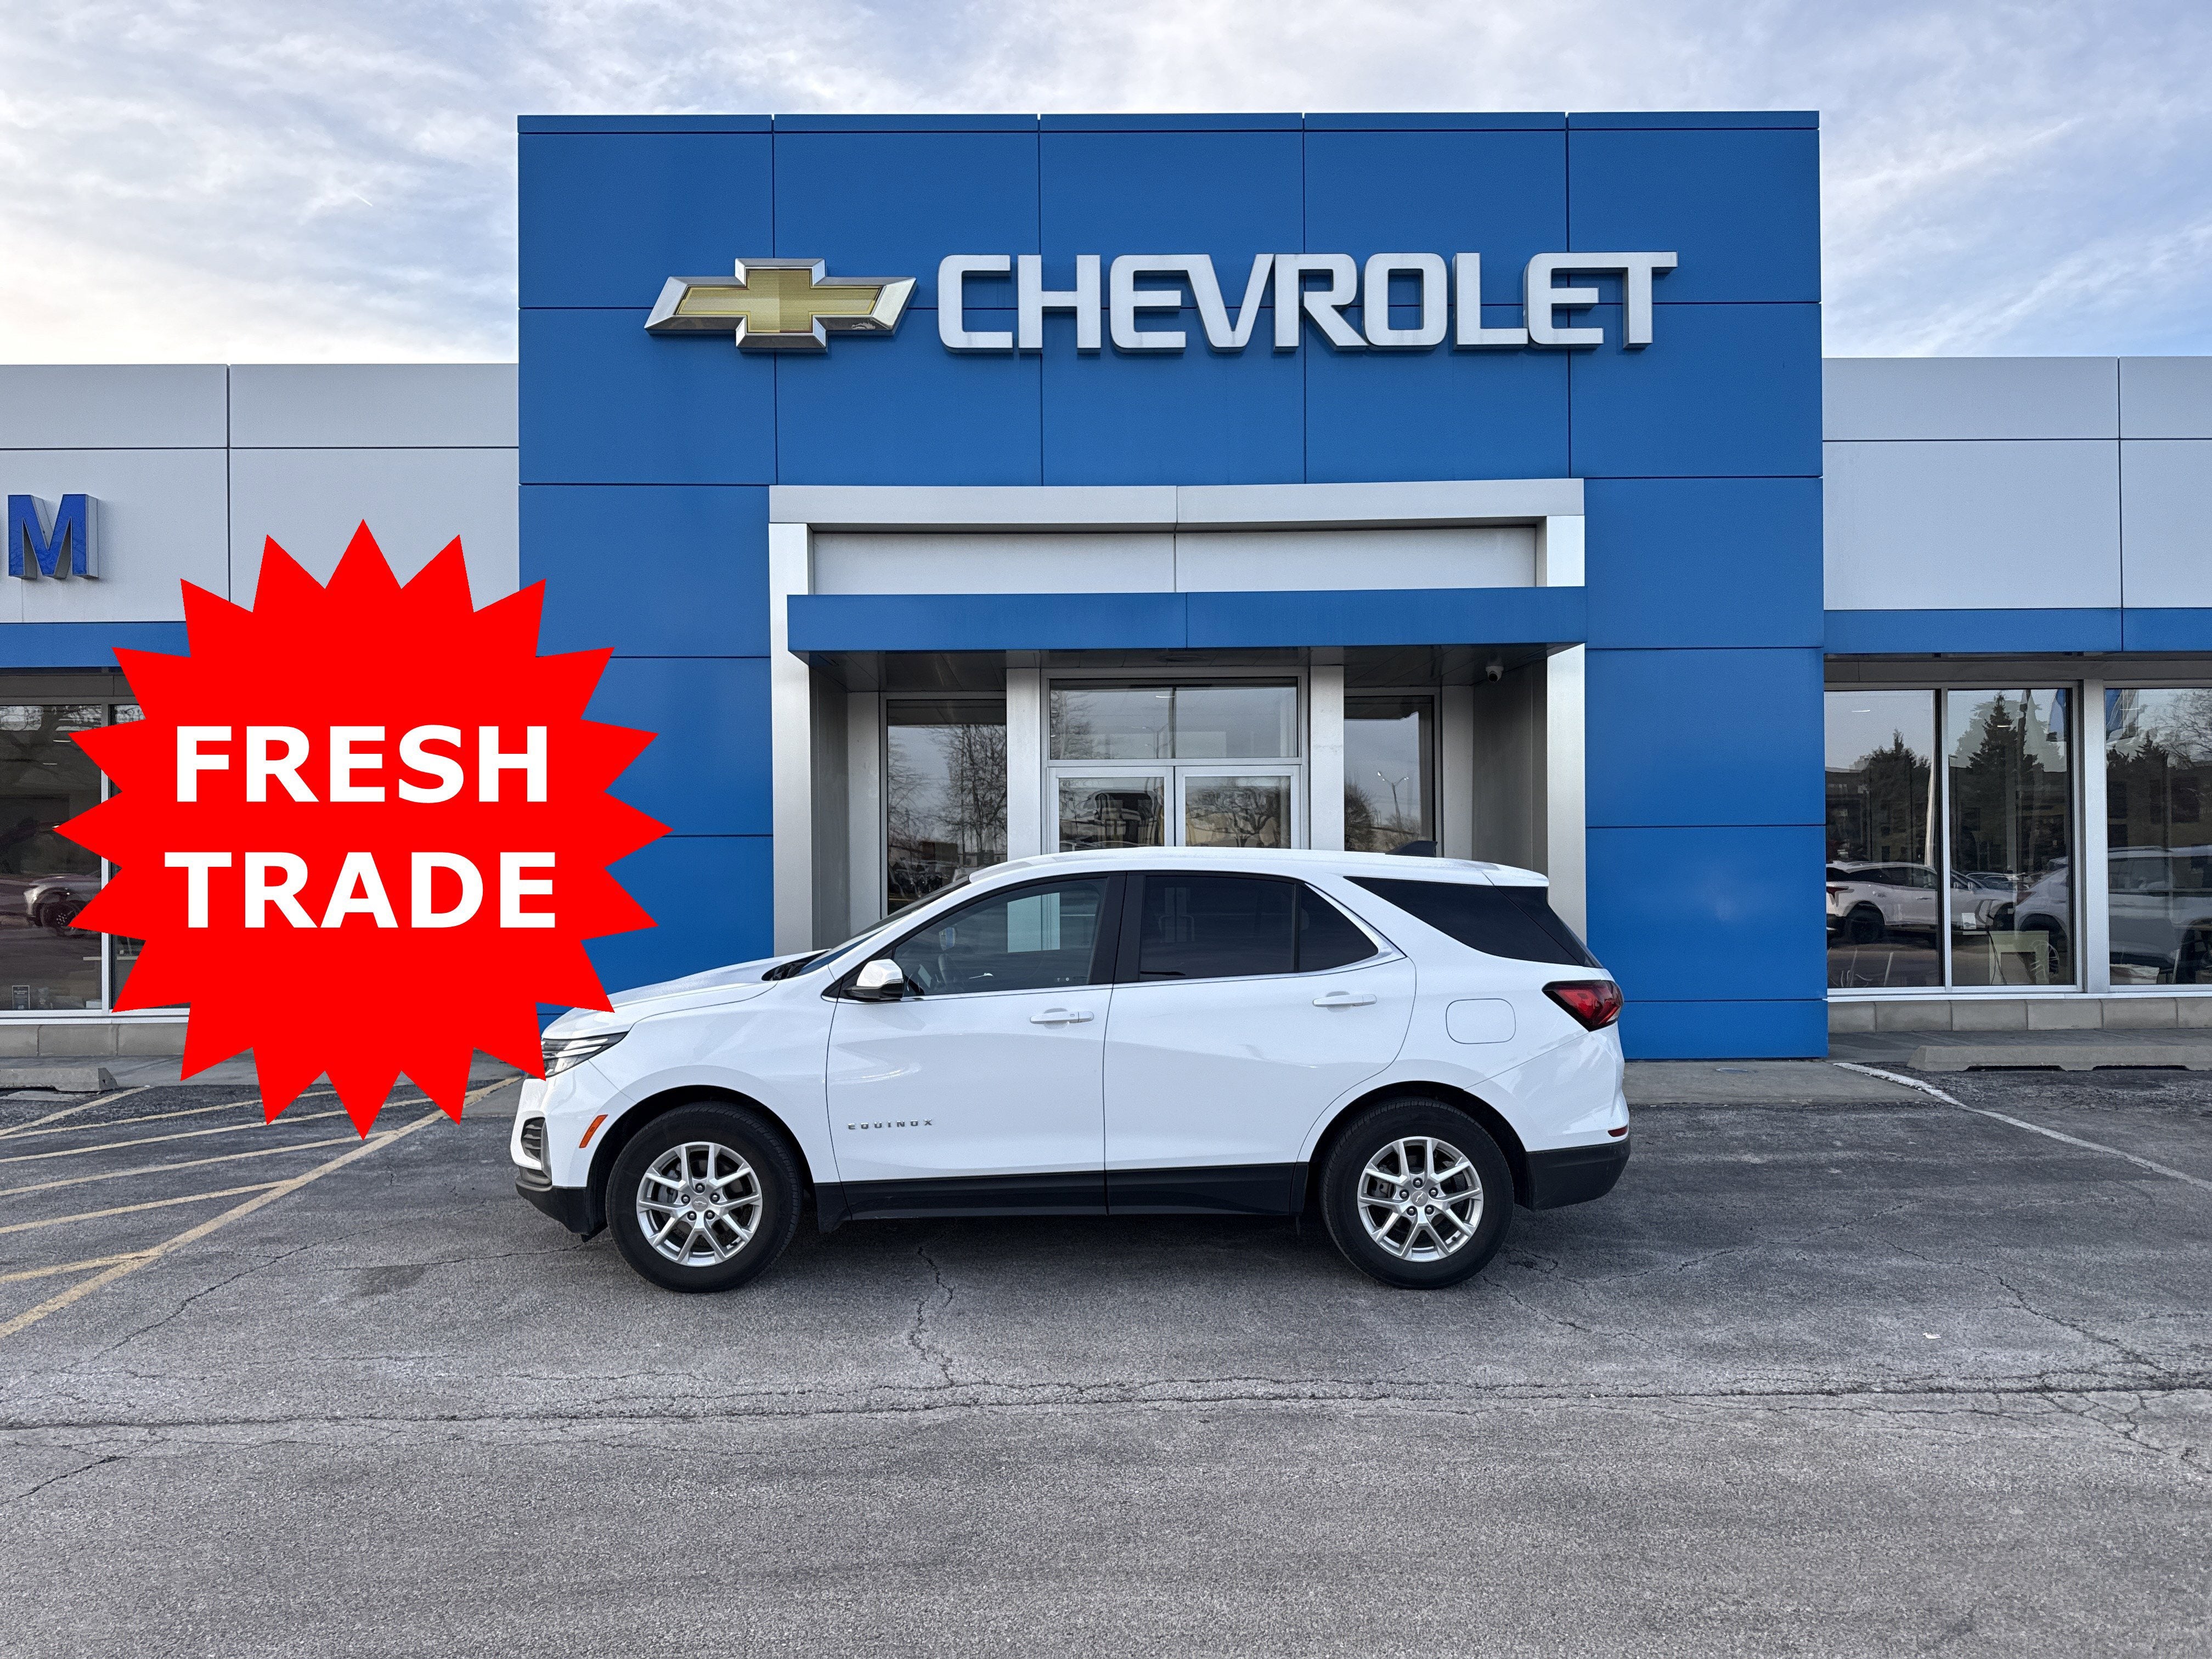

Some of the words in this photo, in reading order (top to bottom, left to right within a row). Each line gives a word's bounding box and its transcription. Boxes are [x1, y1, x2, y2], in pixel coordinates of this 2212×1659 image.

[938, 251, 1678, 353] CHEVROLET
[8, 493, 99, 579] M
[848, 1119, 932, 1130] EQUINOX
